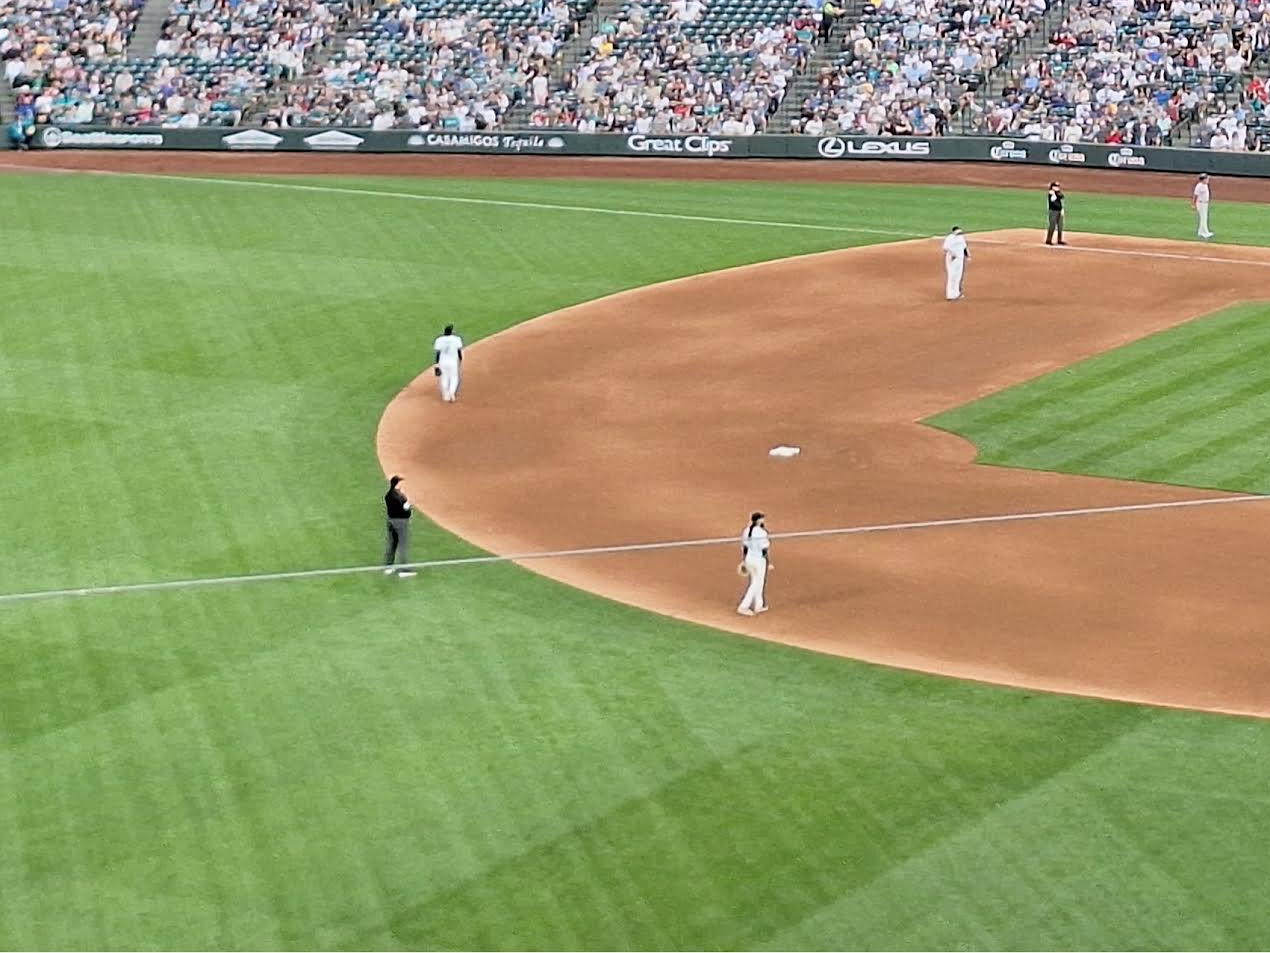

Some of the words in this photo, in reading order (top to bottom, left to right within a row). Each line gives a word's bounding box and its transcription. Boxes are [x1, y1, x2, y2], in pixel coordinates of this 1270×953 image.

[427, 133, 499, 147] CASAMIGOS
[628, 134, 682, 151] Great
[685, 135, 733, 157] Clips
[847, 140, 930, 155] LEXUS
